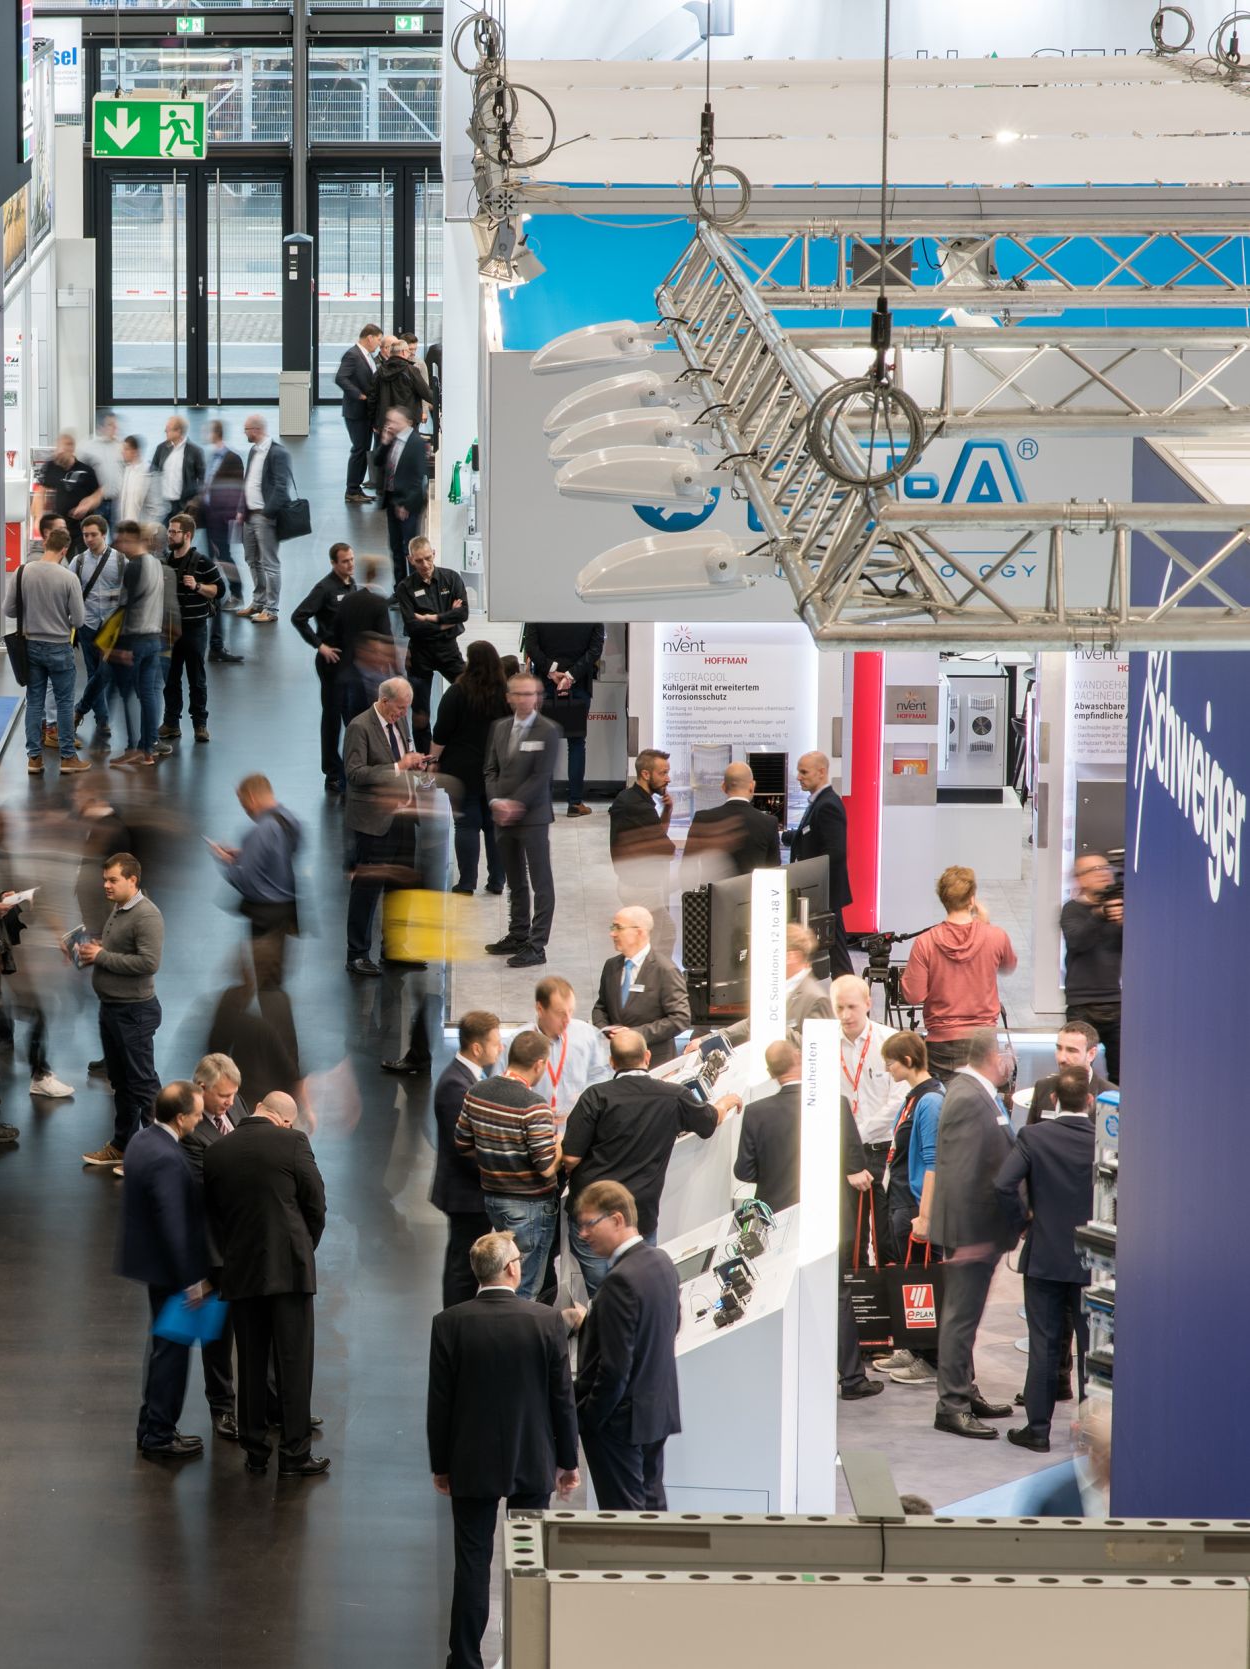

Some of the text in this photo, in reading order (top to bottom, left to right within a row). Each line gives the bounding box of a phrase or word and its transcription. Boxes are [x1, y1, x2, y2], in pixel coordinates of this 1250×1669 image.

[53, 47, 78, 66] sel
[704, 657, 748, 665] HOFFMAN
[662, 672, 727, 682] SPECTRACOOL
[662, 683, 760, 693] Kühlgerät mit erweitertem
[662, 693, 727, 701] Korrosionsschutz
[1074, 691, 1127, 700] DACHNEIGU
[1074, 702, 1126, 710] Abwaschbare
[1074, 711, 1123, 720] empfindliche
[1145, 650, 1247, 904] Schweiger
[771, 889, 780, 897] V
[772, 900, 781, 914] 48
[772, 916, 781, 930] to
[770, 949, 781, 1000] Solutions
[769, 1002, 779, 1021] DC
[806, 1042, 818, 1107] Neuheiten
